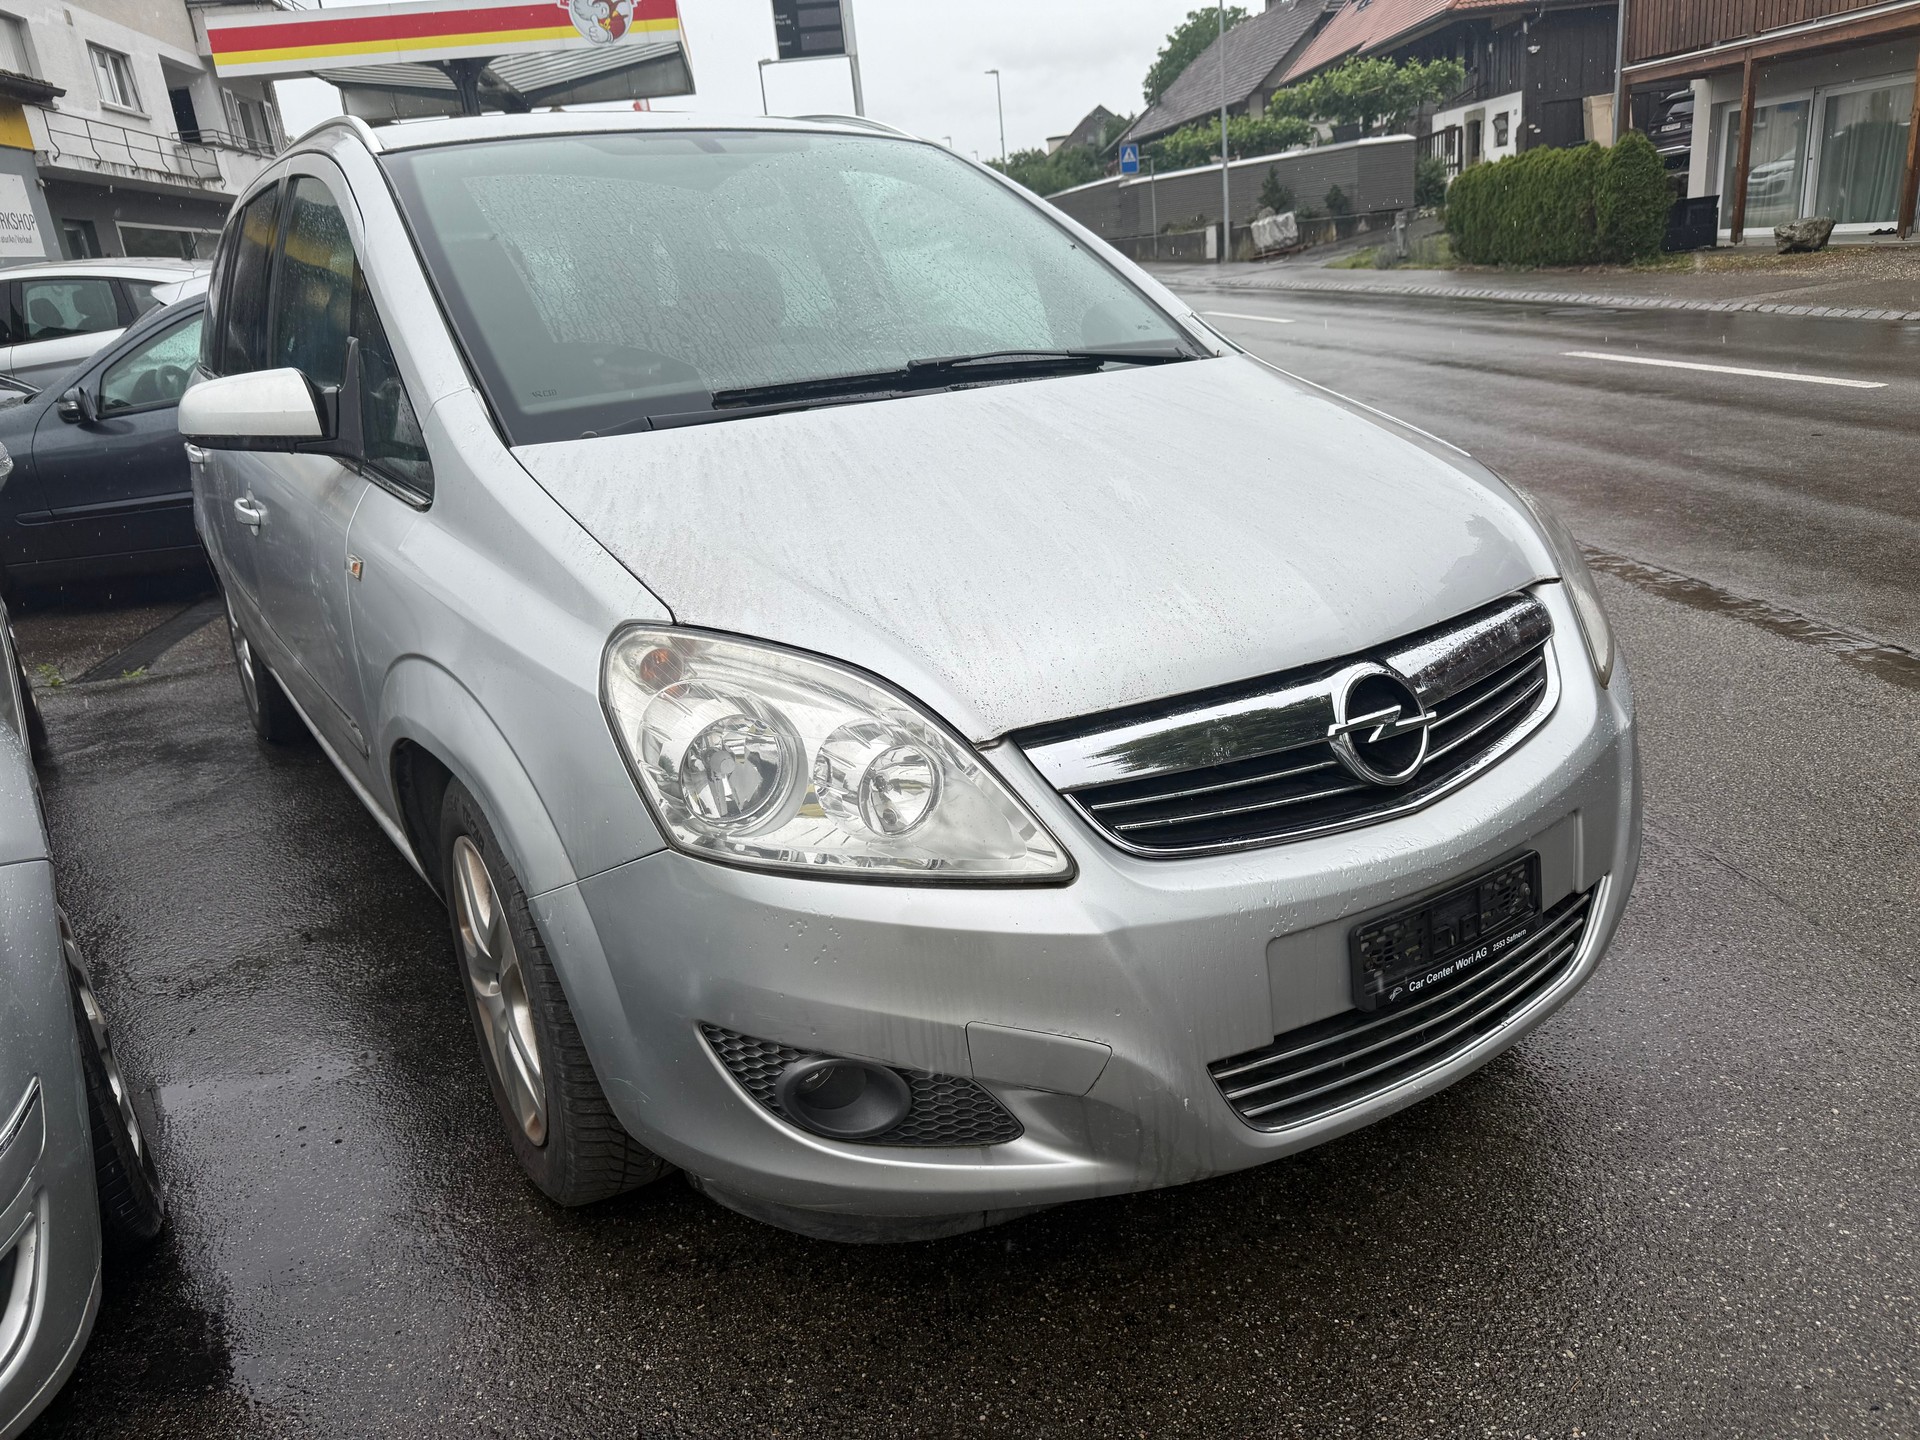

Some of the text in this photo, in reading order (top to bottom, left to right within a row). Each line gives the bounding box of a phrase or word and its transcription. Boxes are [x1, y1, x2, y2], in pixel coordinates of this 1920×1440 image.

[1408, 978, 1425, 992] Car
[1426, 965, 1455, 984] Center
[1455, 953, 1474, 971] Wori
[1475, 946, 1488, 961] AG
